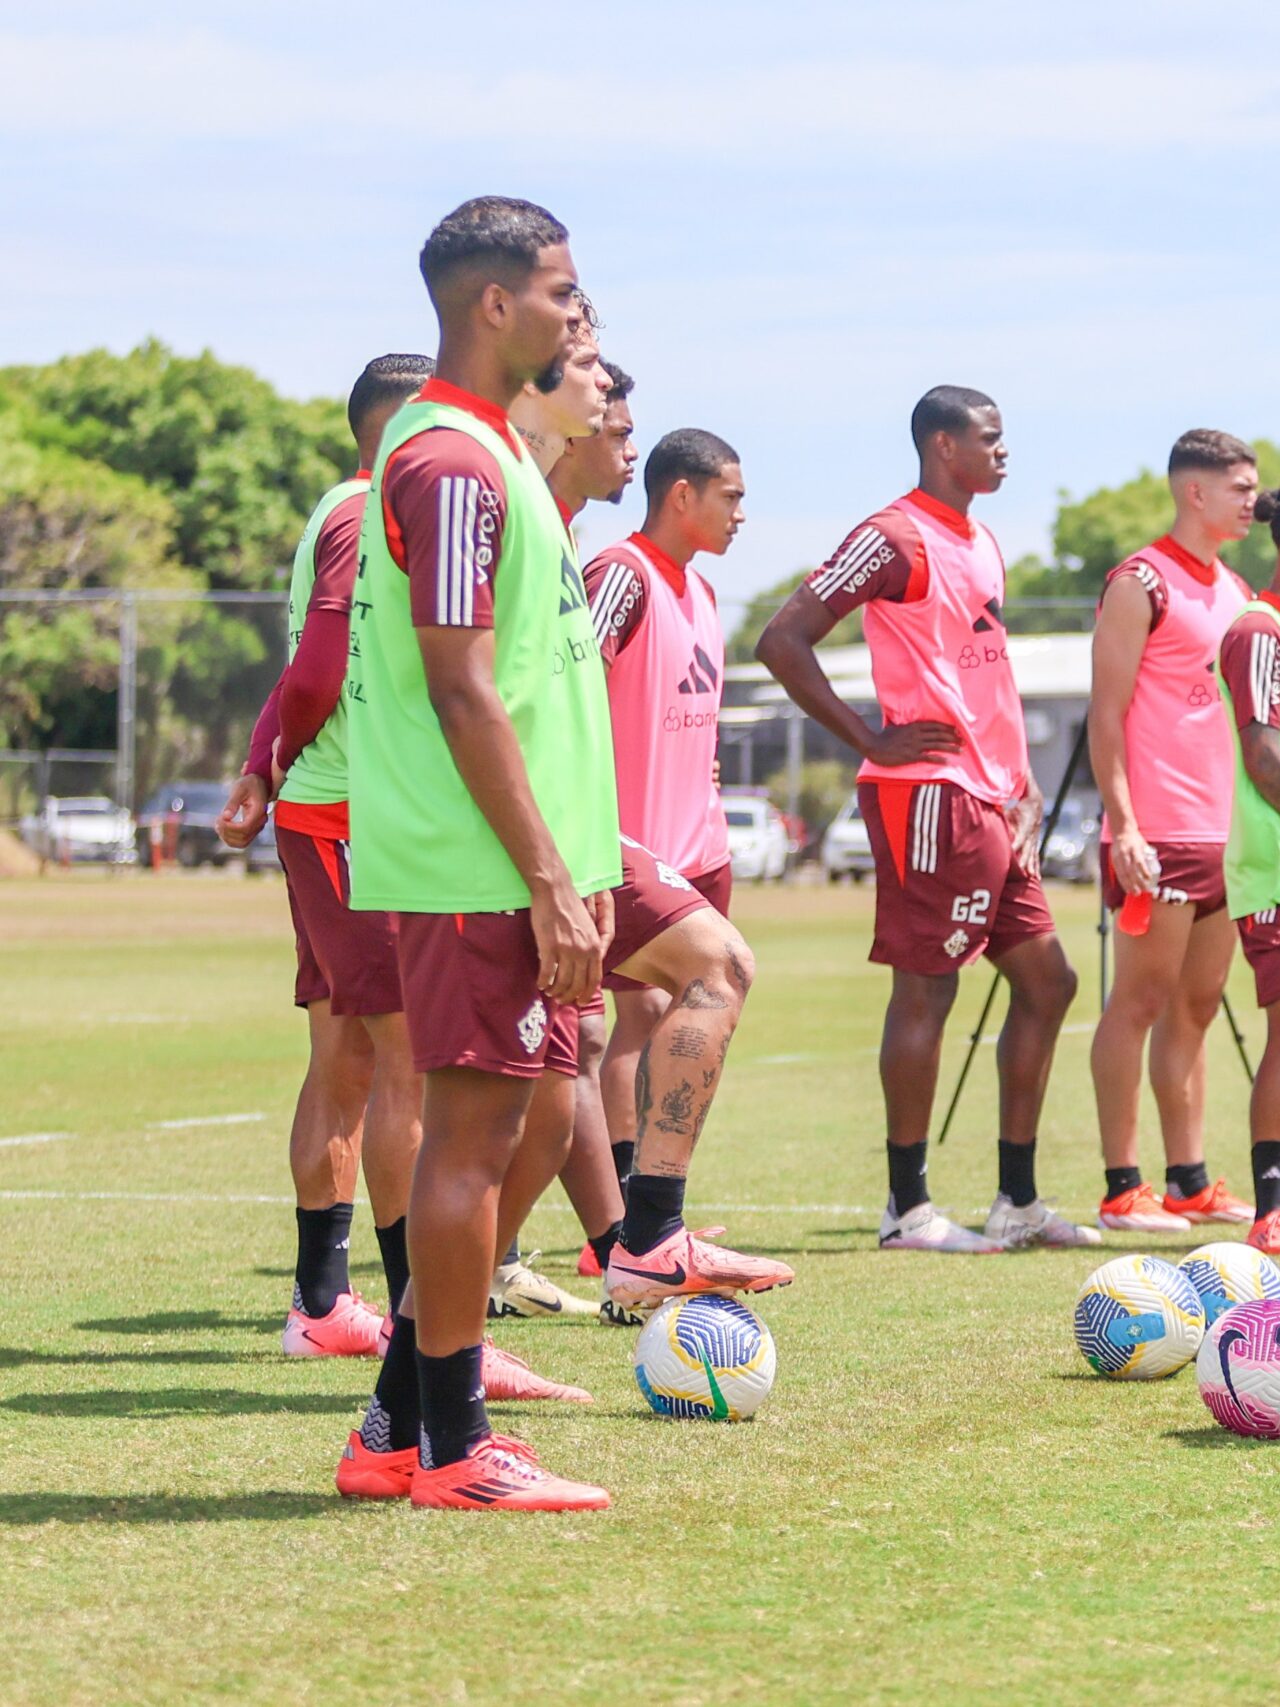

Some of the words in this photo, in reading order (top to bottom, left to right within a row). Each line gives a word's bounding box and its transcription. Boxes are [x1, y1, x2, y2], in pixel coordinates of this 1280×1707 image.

[474, 512, 496, 585] vero
[841, 556, 882, 594] vero
[609, 593, 635, 637] vero
